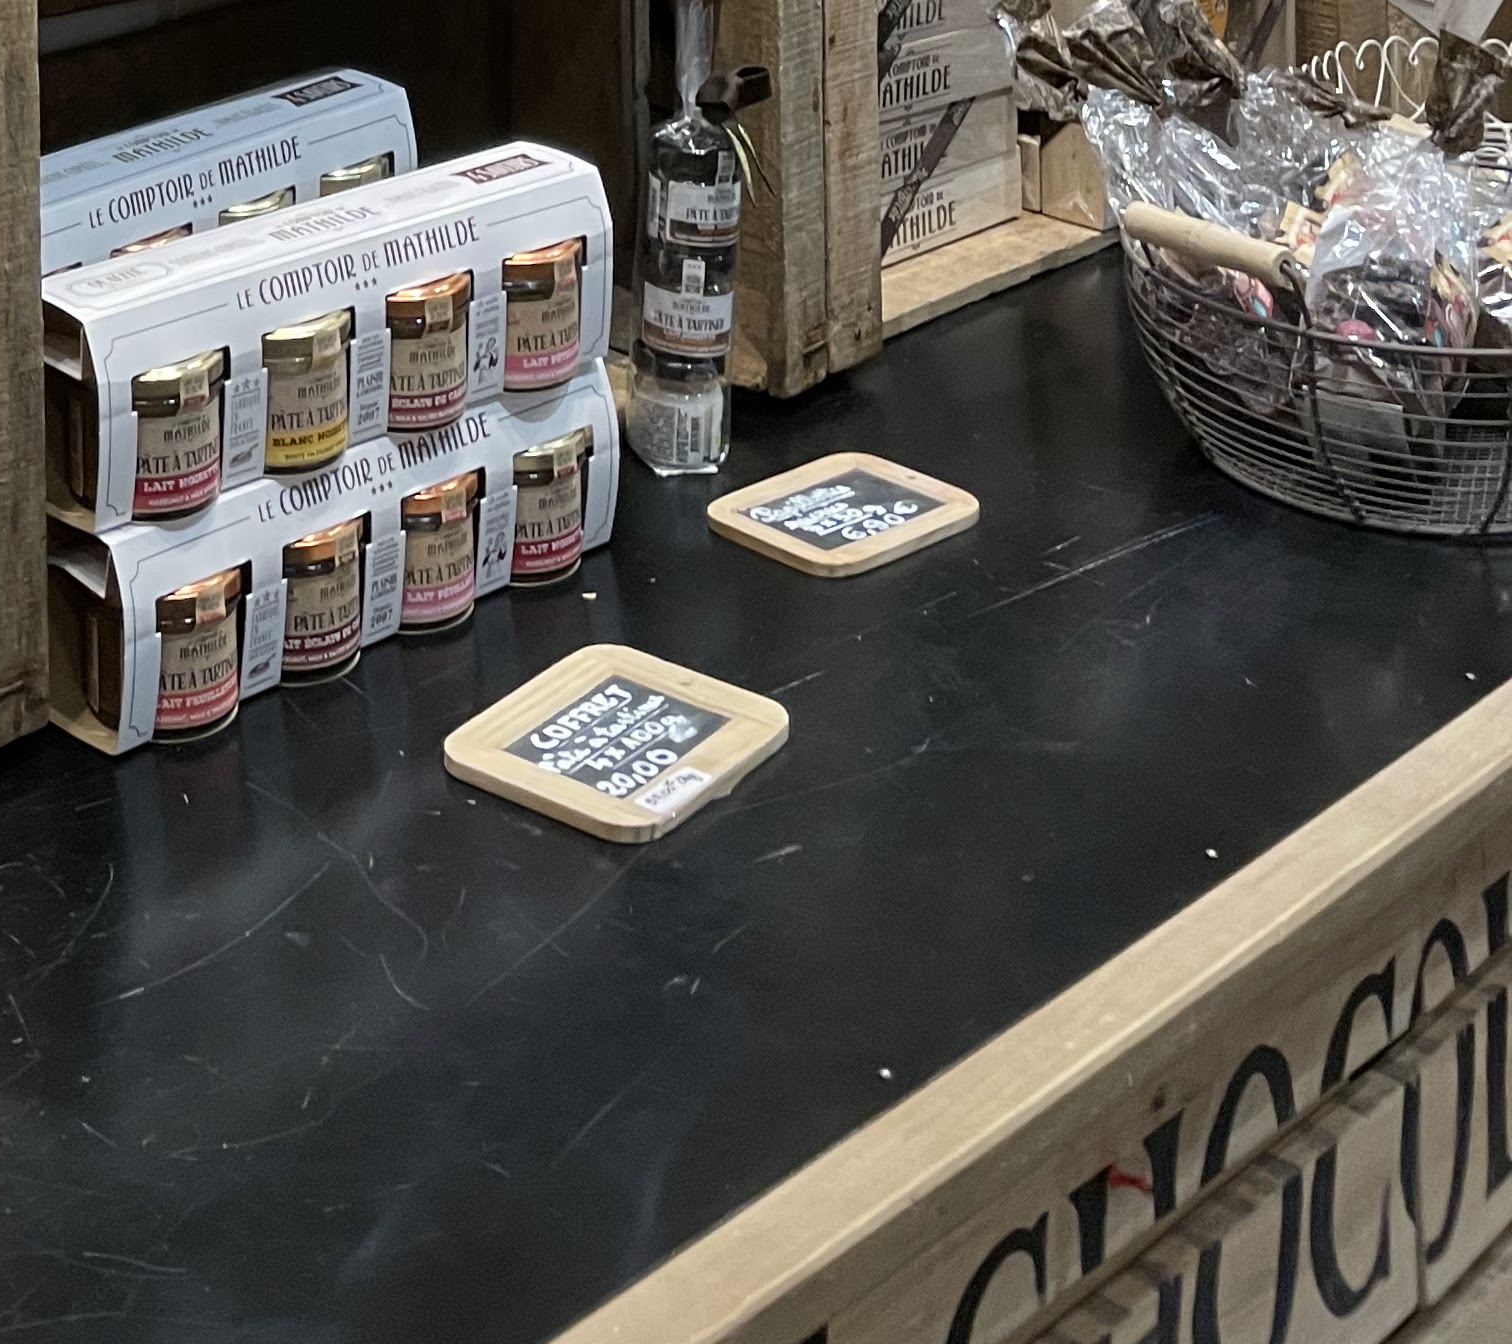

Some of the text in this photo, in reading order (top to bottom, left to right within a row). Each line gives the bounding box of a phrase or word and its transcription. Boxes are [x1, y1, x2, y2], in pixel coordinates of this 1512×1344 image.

[882, 65, 951, 108] ATHILDE
[89, 135, 302, 228] LE COMPTOIR DE MATHILDE
[237, 215, 480, 310] LE COMPTOIR DE MATHILDE
[518, 332, 547, 352] PÂTE
[271, 411, 301, 431] PÂTE
[273, 434, 313, 447] BLANC
[258, 412, 492, 523] LE COMPTOIR DE MATHILDE
[143, 481, 175, 492] LAIT
[522, 543, 548, 555] LAIT
[407, 589, 434, 602] LAIT
[294, 612, 325, 632] PÂTE
[179, 635, 228, 660] MATHILDE
[530, 684, 632, 749] COFFRET
